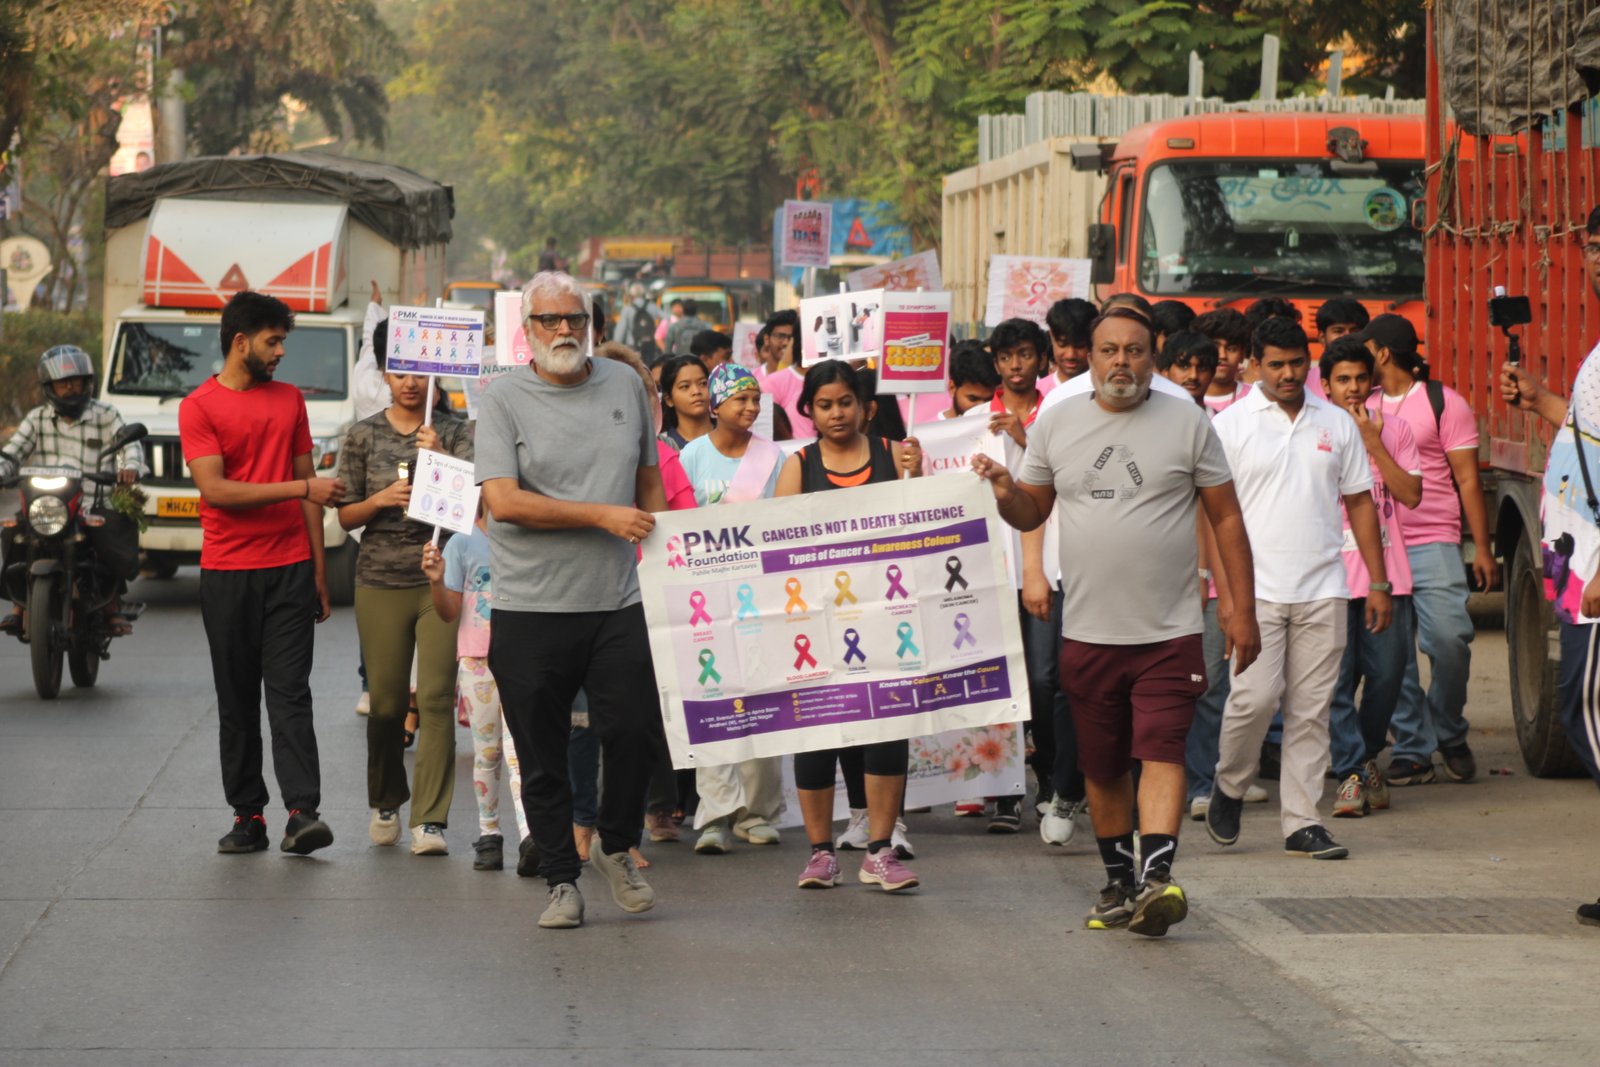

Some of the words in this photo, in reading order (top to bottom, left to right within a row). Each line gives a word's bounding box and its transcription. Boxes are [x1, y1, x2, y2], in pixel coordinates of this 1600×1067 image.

[398, 311, 418, 320] PMK
[427, 454, 432, 466] 5
[1094, 447, 1113, 469] RUN
[1127, 461, 1142, 485] RUN
[1092, 490, 1113, 499] RUN
[683, 525, 754, 556] PMK
[762, 528, 808, 542] CANCER
[811, 524, 822, 536] IS
[826, 520, 848, 534] NOT
[850, 518, 858, 531] A
[861, 514, 896, 530] DEATH
[898, 506, 964, 526] SENTECNCE
[788, 550, 816, 565] Types
[818, 550, 828, 561] of
[829, 546, 862, 558] Cancer
[864, 545, 870, 554] &
[872, 536, 922, 554] Awareness
[924, 534, 961, 548] Colours
[687, 550, 758, 568] Foundation
[943, 672, 963, 680] Know
